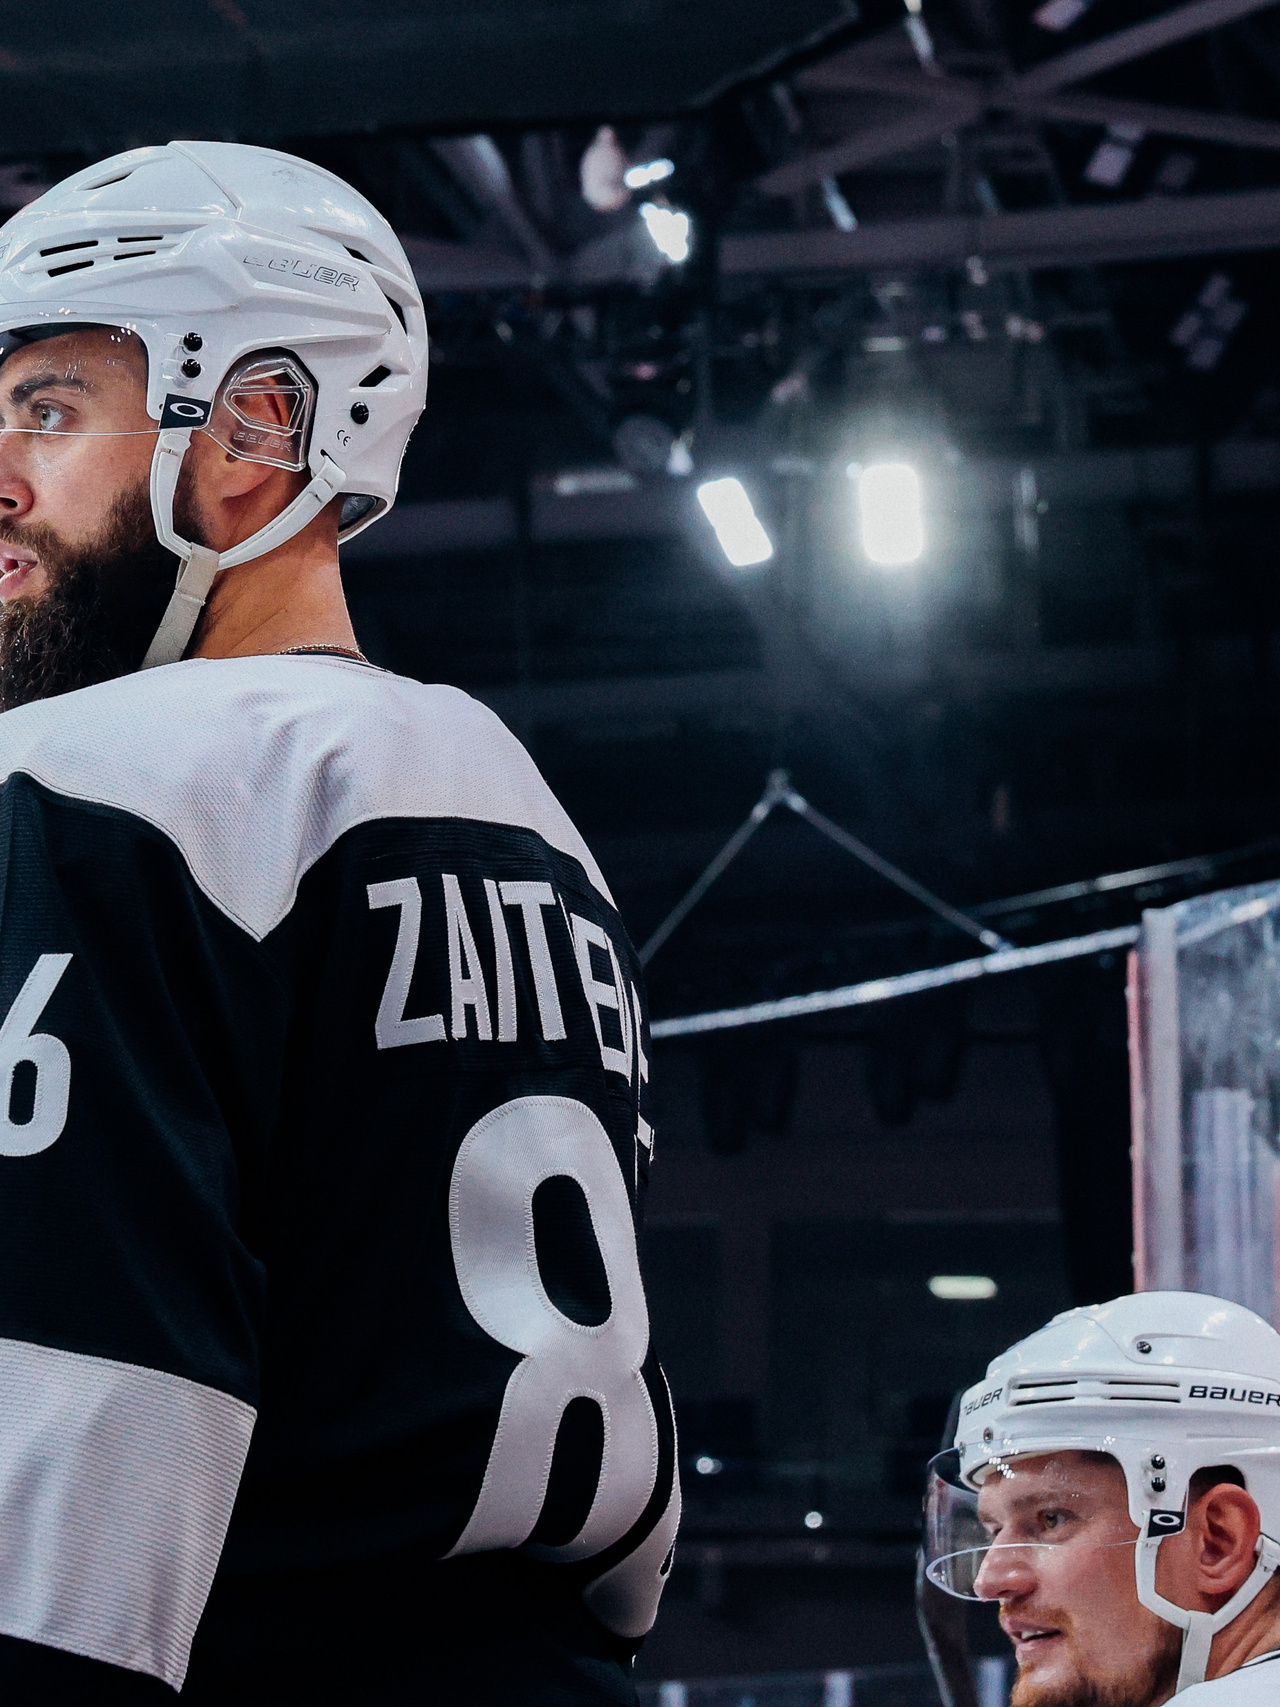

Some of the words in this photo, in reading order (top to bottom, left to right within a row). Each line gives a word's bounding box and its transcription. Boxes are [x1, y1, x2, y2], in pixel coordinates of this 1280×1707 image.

[242, 255, 360, 292] AUER
[367, 873, 649, 1086] ZAITE
[439, 1096, 681, 1638] 8
[963, 1388, 1003, 1415] AUER
